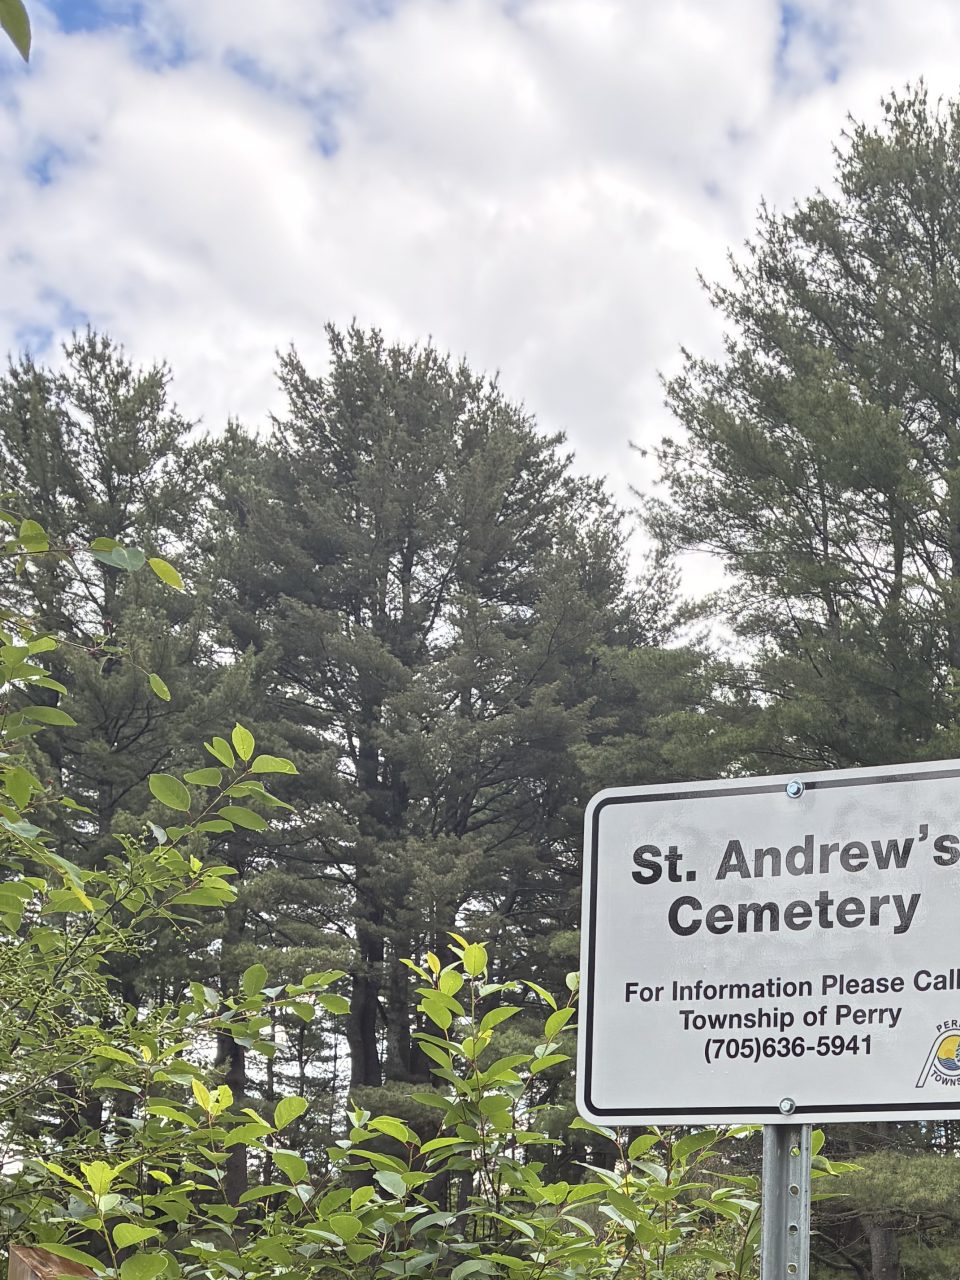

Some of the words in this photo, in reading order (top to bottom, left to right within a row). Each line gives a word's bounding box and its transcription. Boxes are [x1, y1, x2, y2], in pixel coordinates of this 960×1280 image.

[632, 845, 697, 885] St.
[715, 823, 960, 881] Andrew's
[667, 890, 922, 937] Cemetery
[625, 982, 665, 1003] For
[672, 976, 813, 1002] Information
[821, 974, 905, 996] Please
[678, 1006, 795, 1033] Township
[802, 1005, 828, 1027] of
[835, 1004, 903, 1029] Perry
[704, 1034, 872, 1064] (705)636-5941
